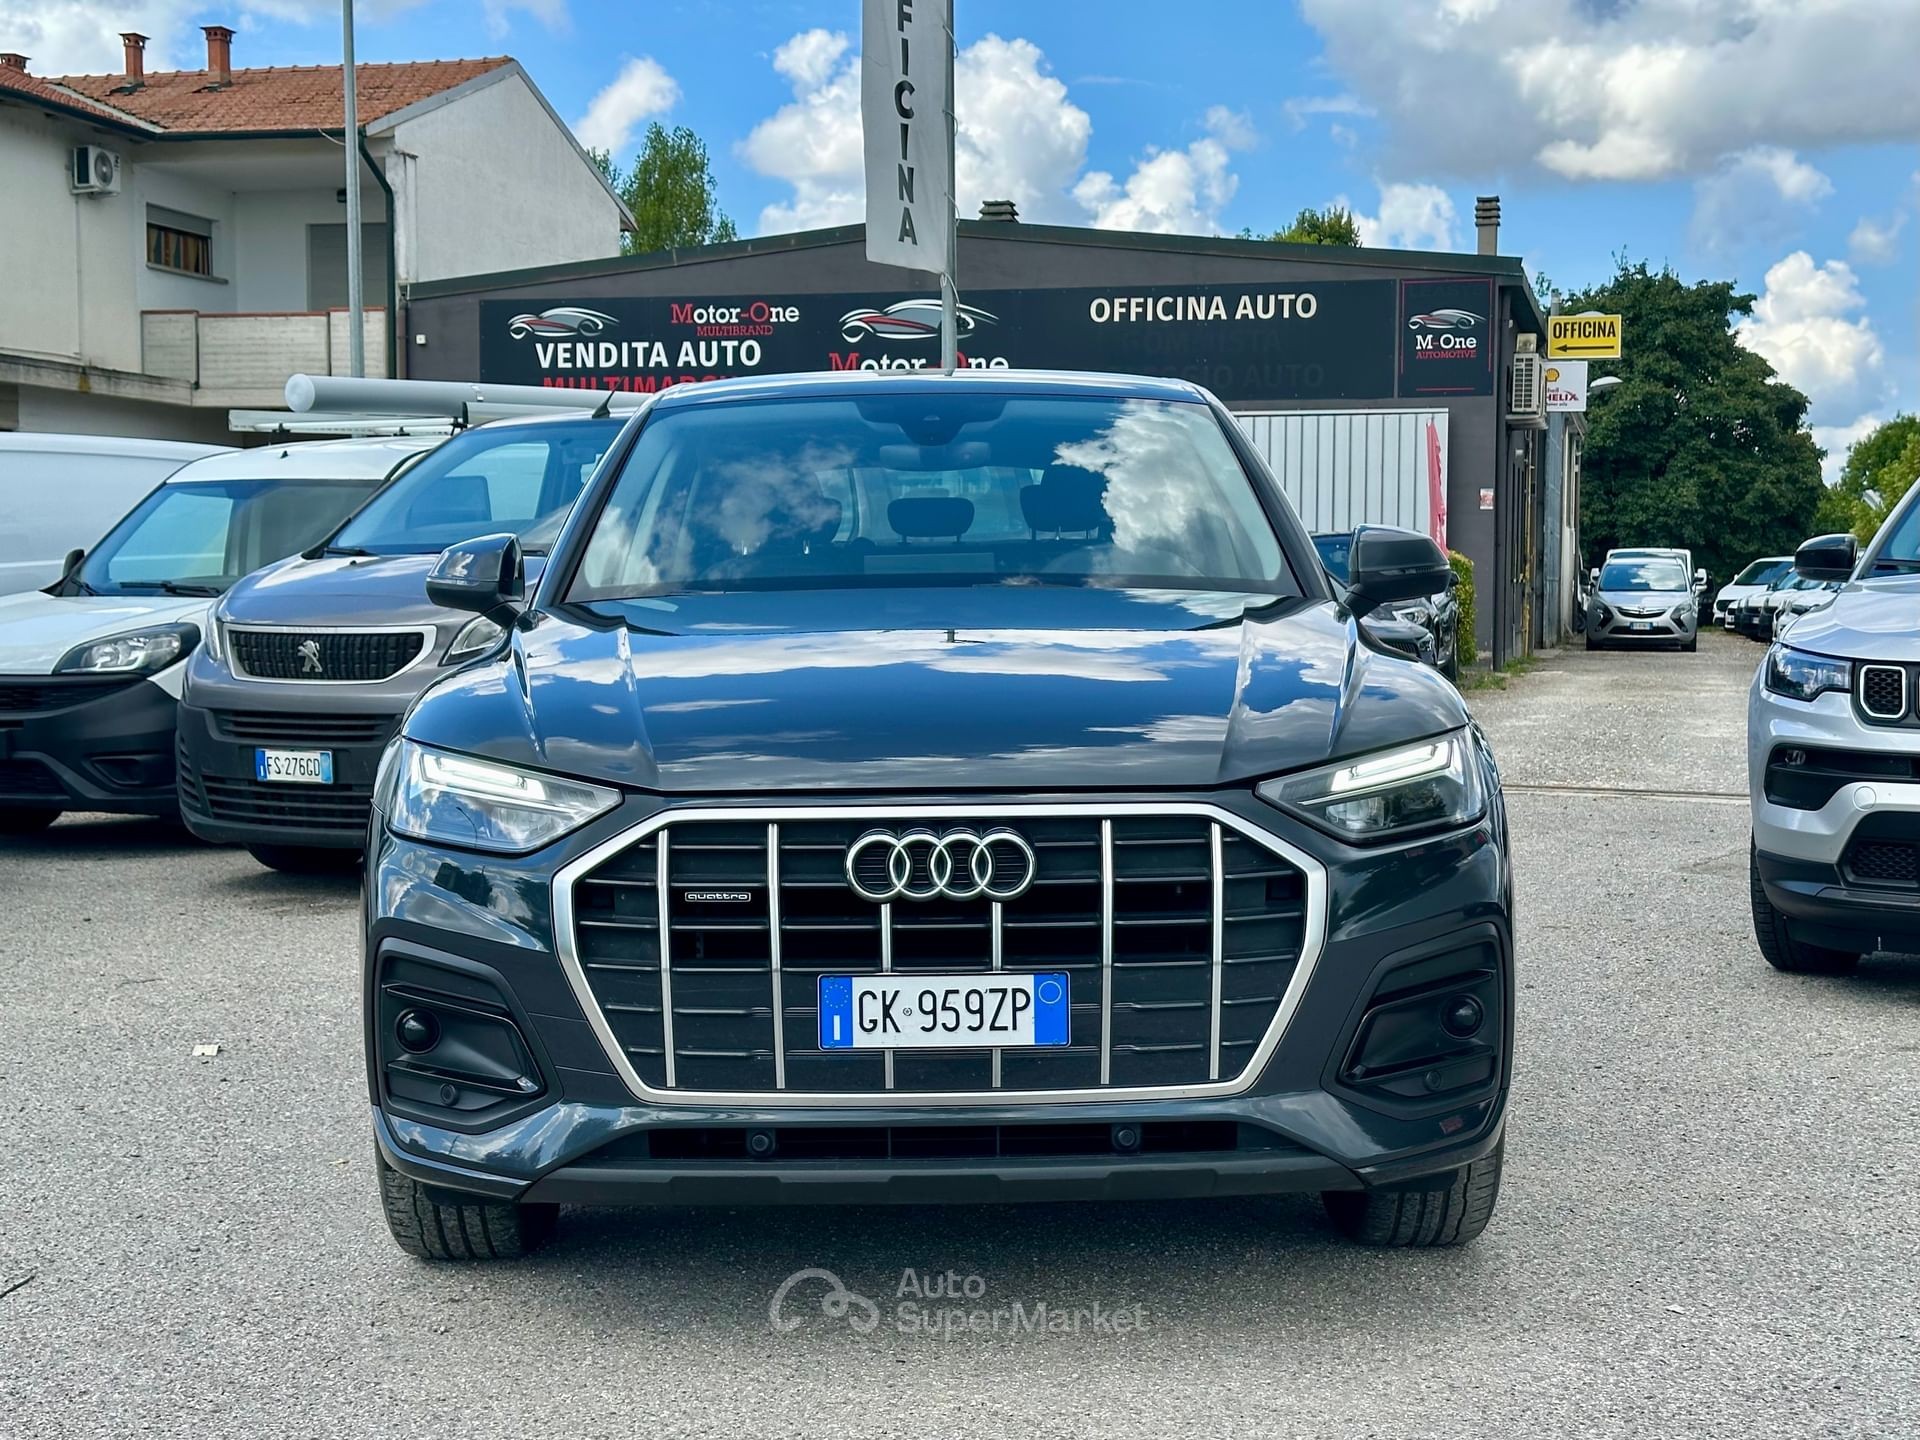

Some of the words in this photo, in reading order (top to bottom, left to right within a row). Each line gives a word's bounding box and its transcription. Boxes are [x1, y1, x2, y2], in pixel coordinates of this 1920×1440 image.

[671, 302, 800, 324] Motor-One
[1089, 296, 1227, 323] OFFICINA
[1235, 293, 1318, 320] AUTO
[696, 325, 773, 337] MULTIBRAND
[1552, 321, 1616, 339] OFFICINA
[1415, 334, 1477, 350] M-One
[535, 341, 669, 369] VENDITA
[677, 340, 761, 368] AUTO
[1416, 349, 1477, 359] AUTOMOTIVE
[266, 756, 281, 775] FS
[687, 893, 748, 901] quattro
[858, 990, 901, 1033] GK
[917, 987, 1031, 1033] 959ZP
